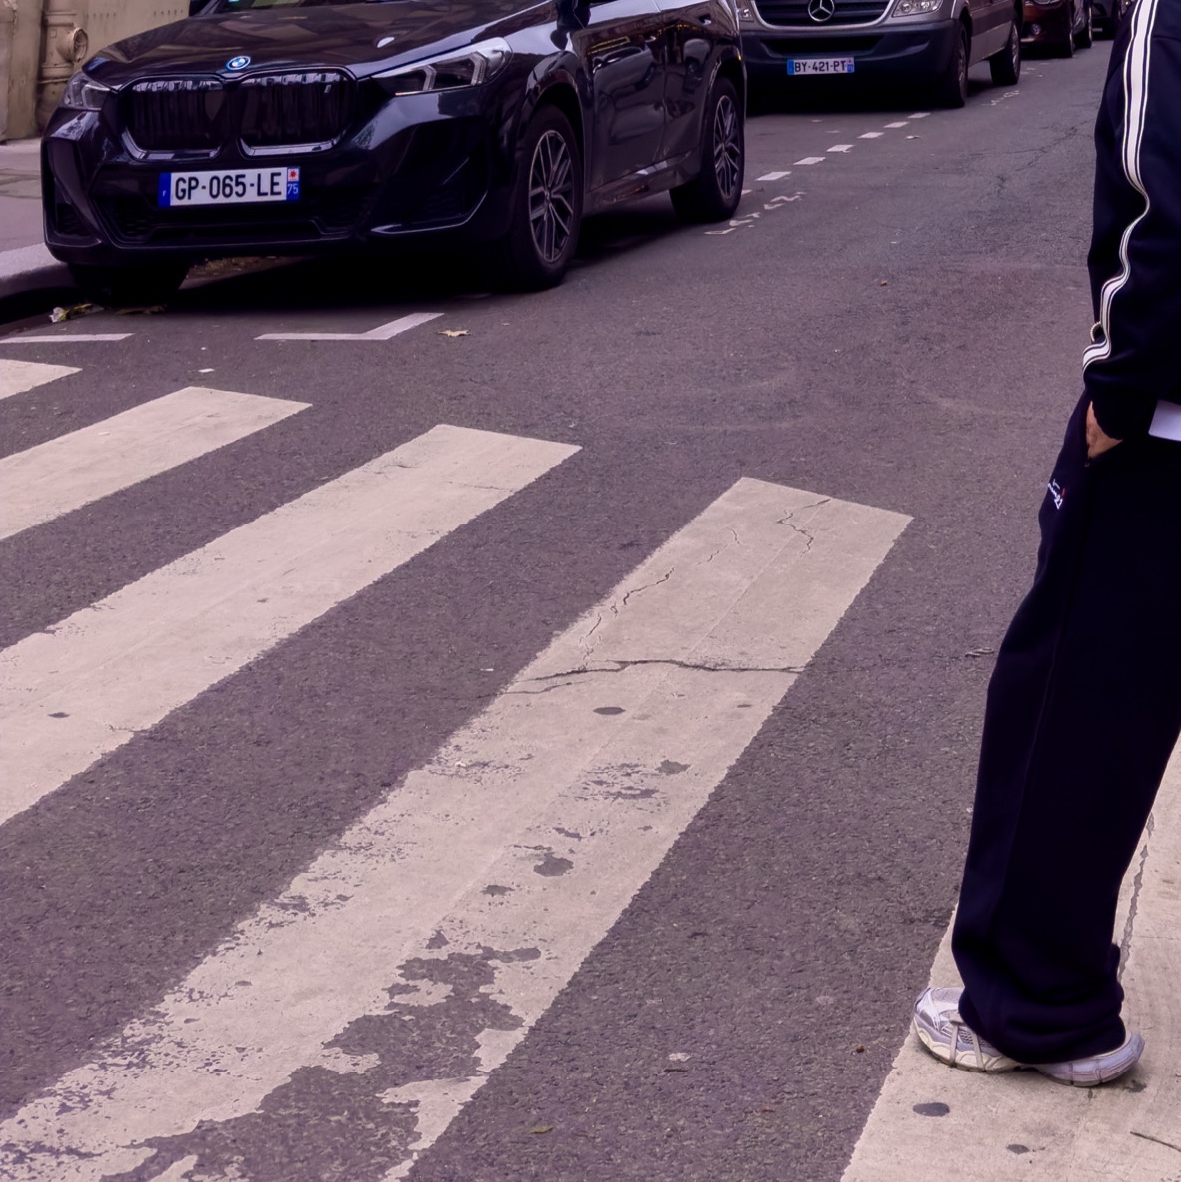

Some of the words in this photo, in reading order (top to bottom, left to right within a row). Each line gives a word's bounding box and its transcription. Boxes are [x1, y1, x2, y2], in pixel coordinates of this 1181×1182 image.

[794, 60, 847, 73] BY-421-PT
[174, 171, 282, 201] GP-065-LE
[287, 182, 299, 195] 75
